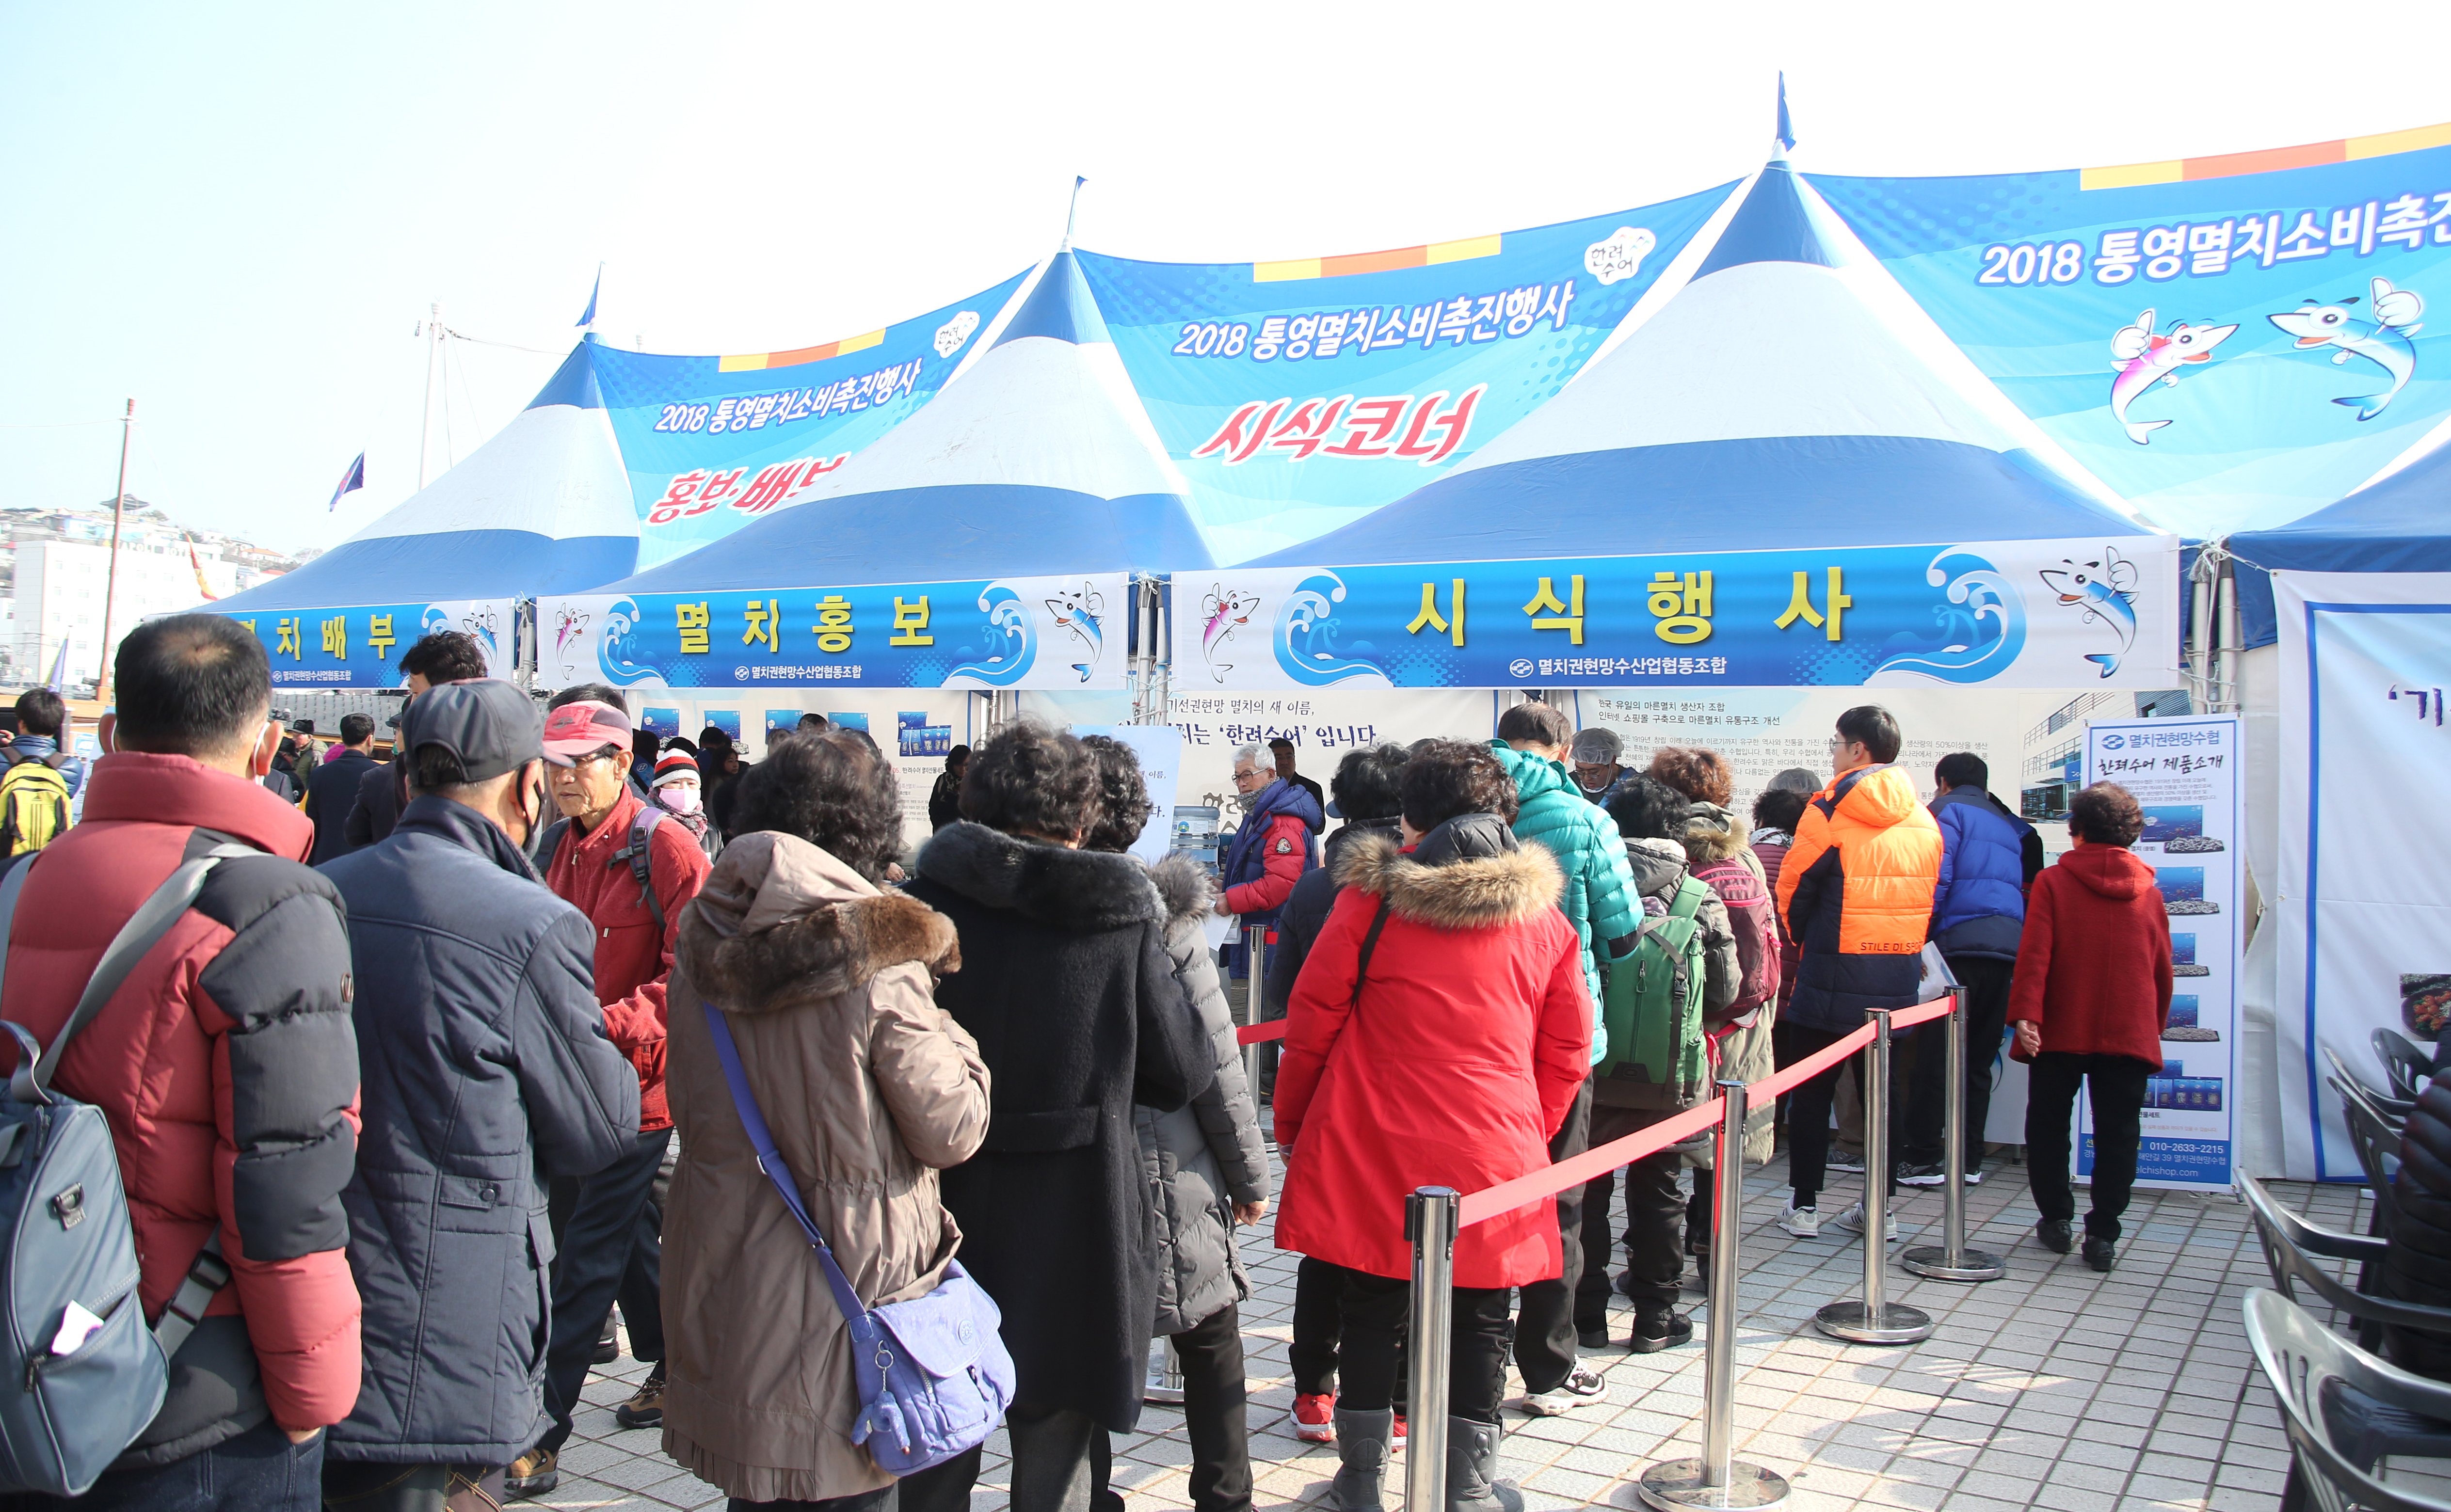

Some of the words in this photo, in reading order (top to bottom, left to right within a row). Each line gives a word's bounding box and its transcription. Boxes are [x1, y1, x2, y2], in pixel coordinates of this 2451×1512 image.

[1979, 243, 2083, 286] 2018
[1173, 323, 1247, 358] 2018
[1252, 280, 1574, 359] 통영멸치소비촉진행사
[655, 404, 707, 431] 2018
[708, 358, 922, 433] 통영멸치소비촉진행사
[1194, 387, 1484, 464] 시식코너
[117, 540, 155, 553] APOLI
[752, 665, 862, 679] 멸치권현망수산업협동조합
[1538, 656, 1727, 675] 멸치권현망수산업협동조합
[283, 670, 352, 681] 멸치권현망수산업협동조합
[1167, 698, 1225, 714] 기선권현망
[1231, 700, 1264, 715] 멸치의
[1269, 700, 1282, 715] 새
[1287, 700, 1314, 716] 이름,
[1598, 699, 1612, 709] 한국
[1615, 700, 1641, 710] 유일의
[1644, 701, 1677, 711] 마른멸치
[1680, 701, 1705, 712] 생산자
[1708, 702, 1725, 712] 조합
[1598, 711, 1620, 722] 인터넷
[1623, 714, 1649, 723] 쇼핑몰
[1652, 715, 1686, 724] 구축으로
[1689, 716, 1722, 725] 마른멸치
[1725, 716, 1759, 725] 유통구조
[1763, 716, 1780, 726] 개선
[1906, 740, 1932, 748] 생산량의
[1935, 741, 1971, 749] 50%이상을
[1974, 742, 1988, 750] 생산
[2129, 730, 2220, 748] 멸치권현망수협
[2098, 756, 2154, 776] 한려수어
[2163, 754, 2224, 775] 제품소개
[1149, 771, 1166, 779] 이름,
[1860, 942, 1890, 951] STILE
[1892, 943, 1903, 951] DI
[2149, 1142, 2224, 1154] 010-2633-2215
[2174, 1154, 2227, 1165] 멸치권현망수협
[2135, 1165, 2199, 1177] elchishop.com
